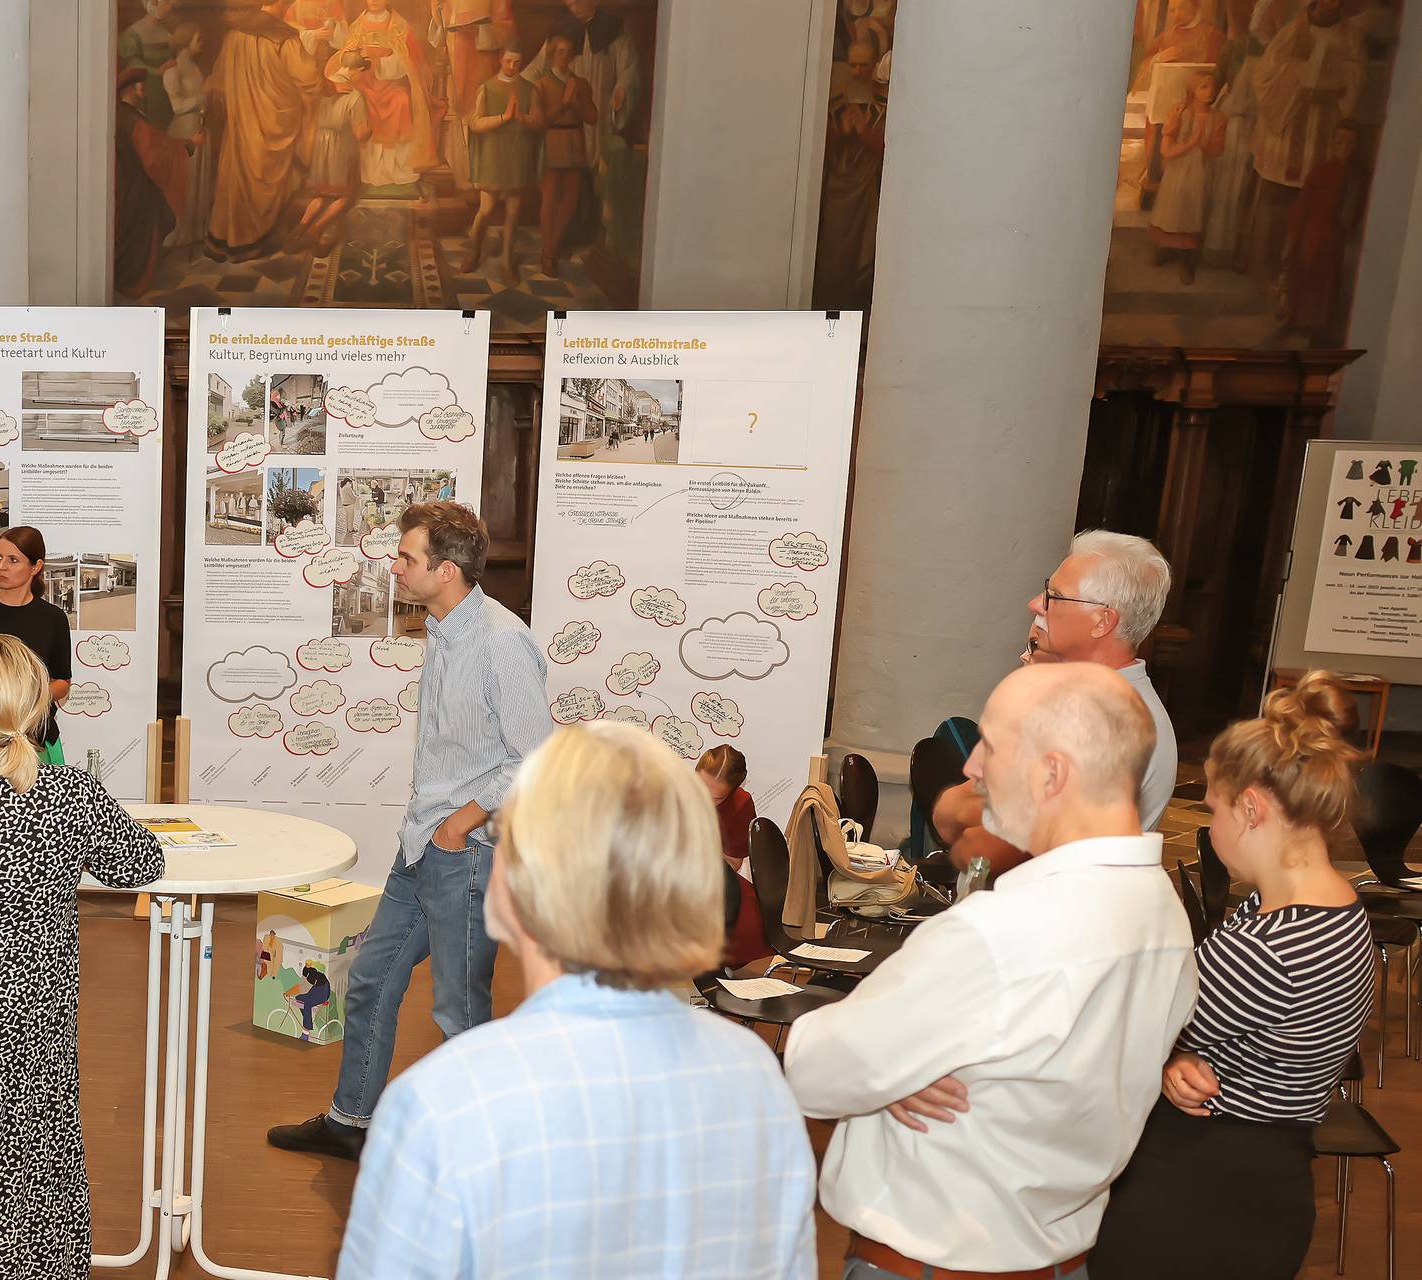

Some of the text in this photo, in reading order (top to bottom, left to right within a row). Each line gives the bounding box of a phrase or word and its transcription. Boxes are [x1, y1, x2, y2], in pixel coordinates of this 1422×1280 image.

[20, 332, 58, 343] Straße
[209, 334, 436, 348] Die einladende und geschäftige Straße
[563, 338, 707, 350] Leitbild Großkölnstraße
[46, 347, 68, 359] und
[71, 347, 107, 359] Kultur
[209, 350, 407, 363] Kultur, Begrünung und vieles mehr
[562, 353, 680, 366] Reflexion & Ausblick
[747, 412, 759, 434] ?
